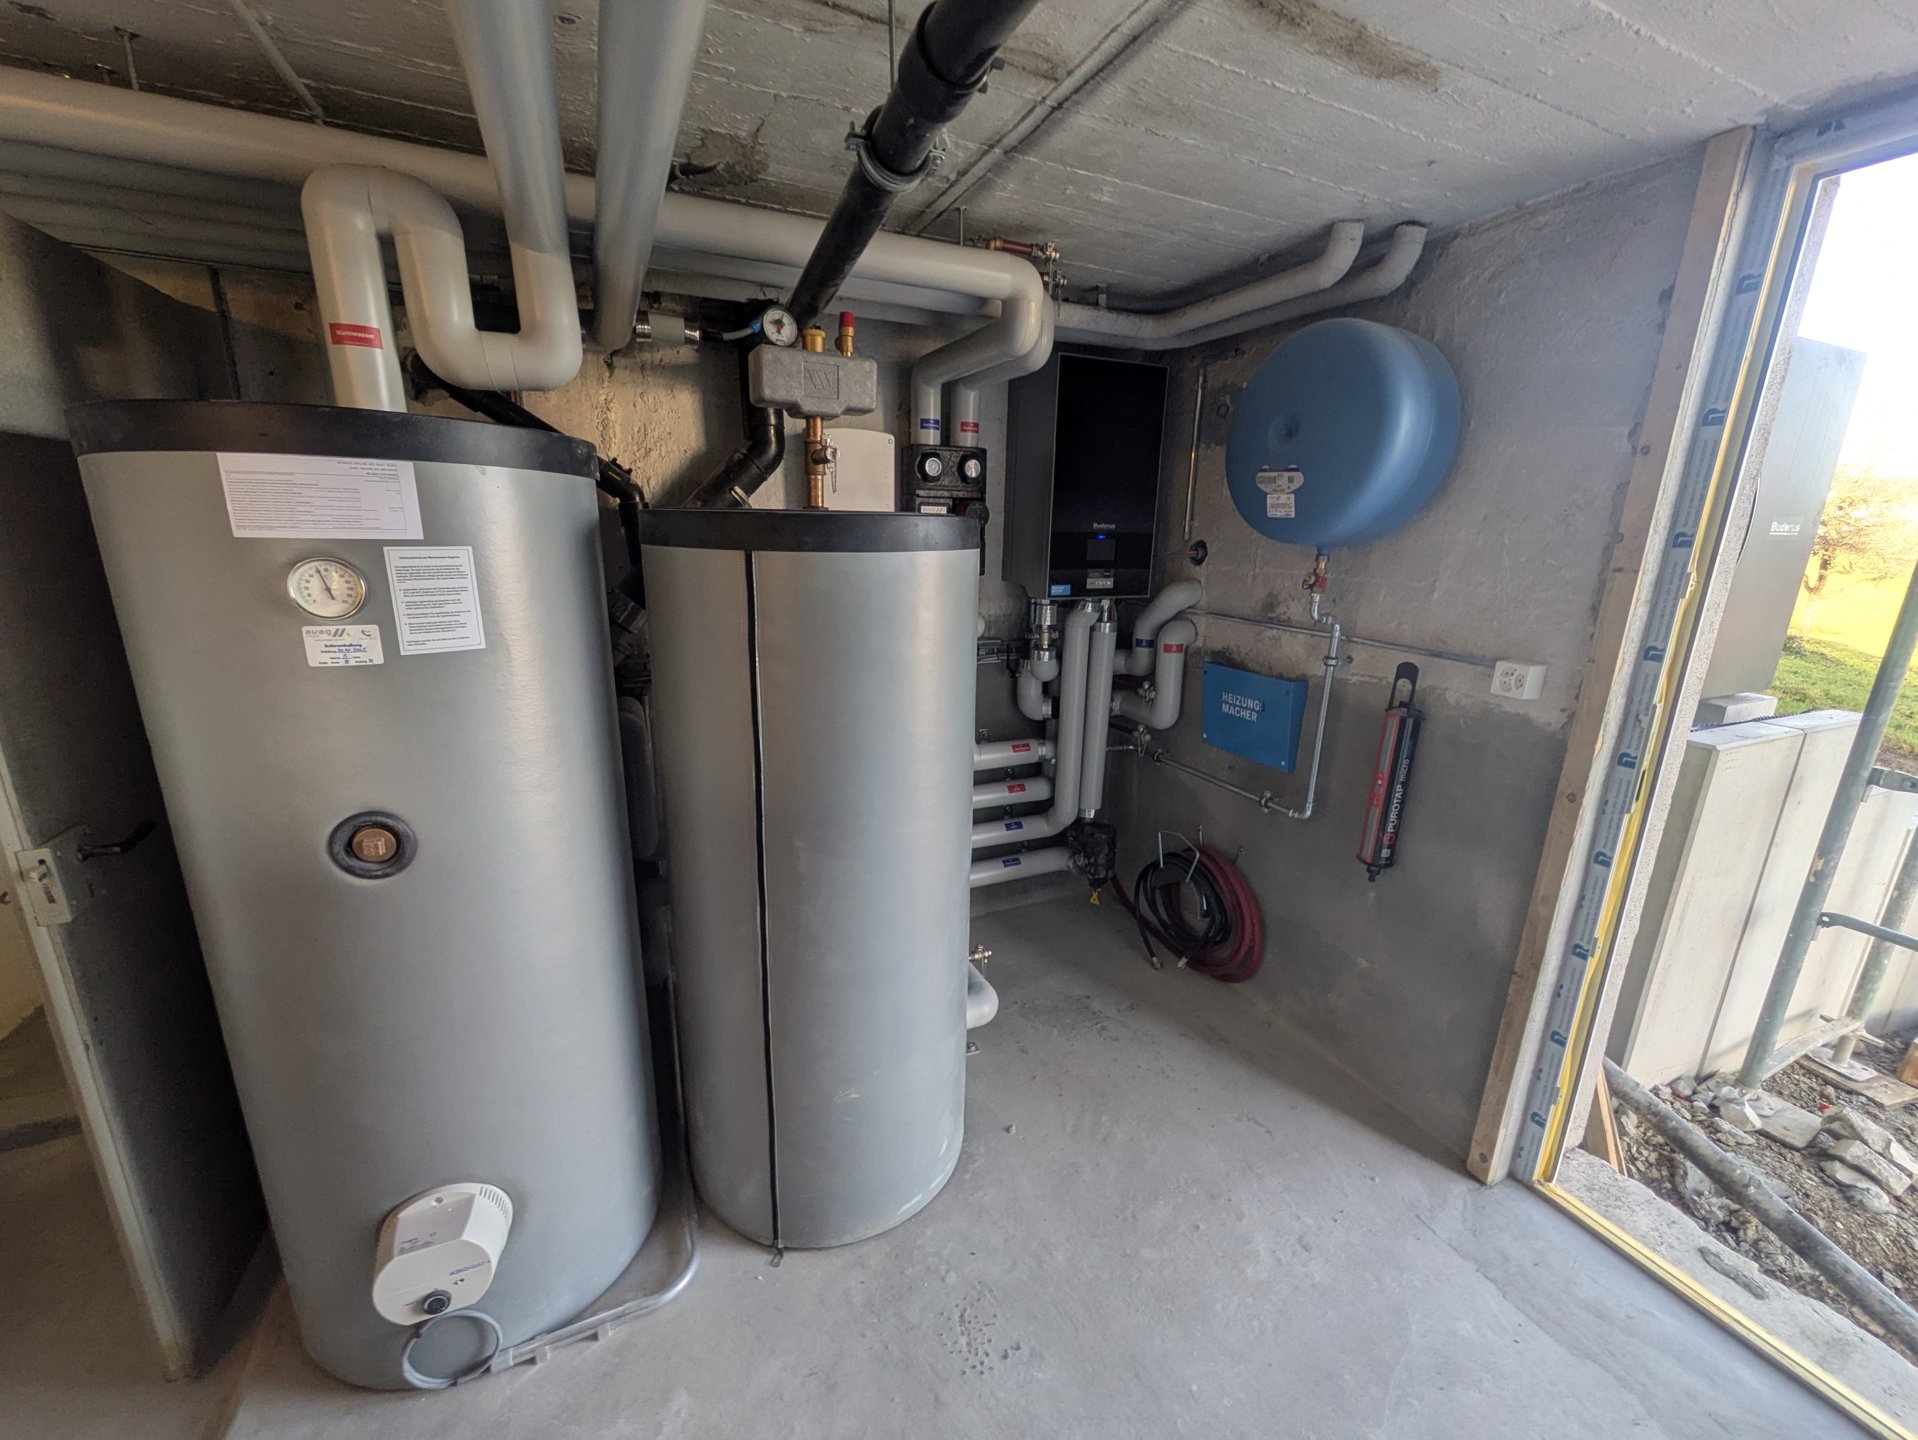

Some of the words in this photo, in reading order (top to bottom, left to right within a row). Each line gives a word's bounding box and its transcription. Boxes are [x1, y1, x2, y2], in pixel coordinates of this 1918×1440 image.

[1770, 521, 1801, 533] Buderus
[1222, 703, 1258, 723] MACHER
[1388, 784, 1404, 832] PUROTAP
[1399, 759, 1409, 782] micro
